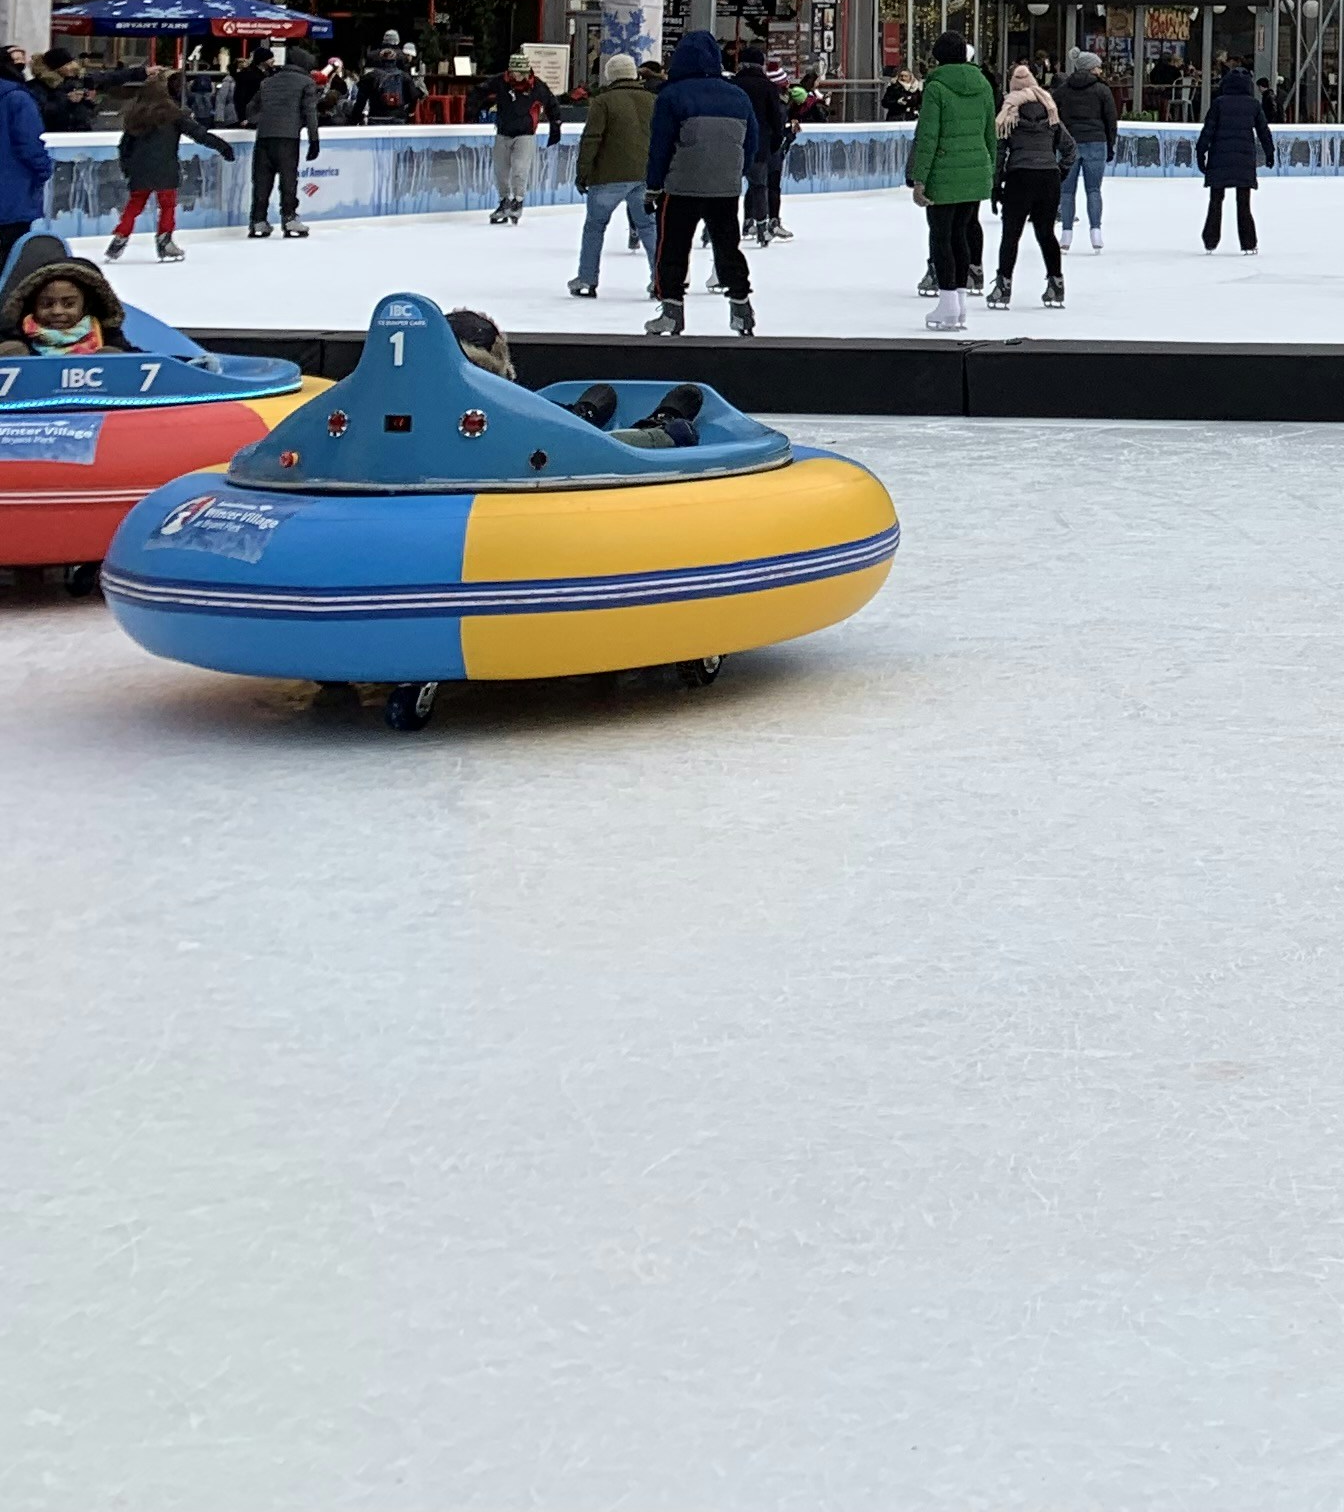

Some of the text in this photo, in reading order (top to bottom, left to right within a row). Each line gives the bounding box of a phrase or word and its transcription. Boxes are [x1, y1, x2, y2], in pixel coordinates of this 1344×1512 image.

[161, 22, 189, 30] PARK
[310, 166, 340, 178] America
[389, 304, 413, 317] IBC
[389, 330, 405, 367] 1
[0, 363, 161, 397] 7 IBC 7
[44, 426, 95, 439] Village
[239, 511, 279, 530] Village
